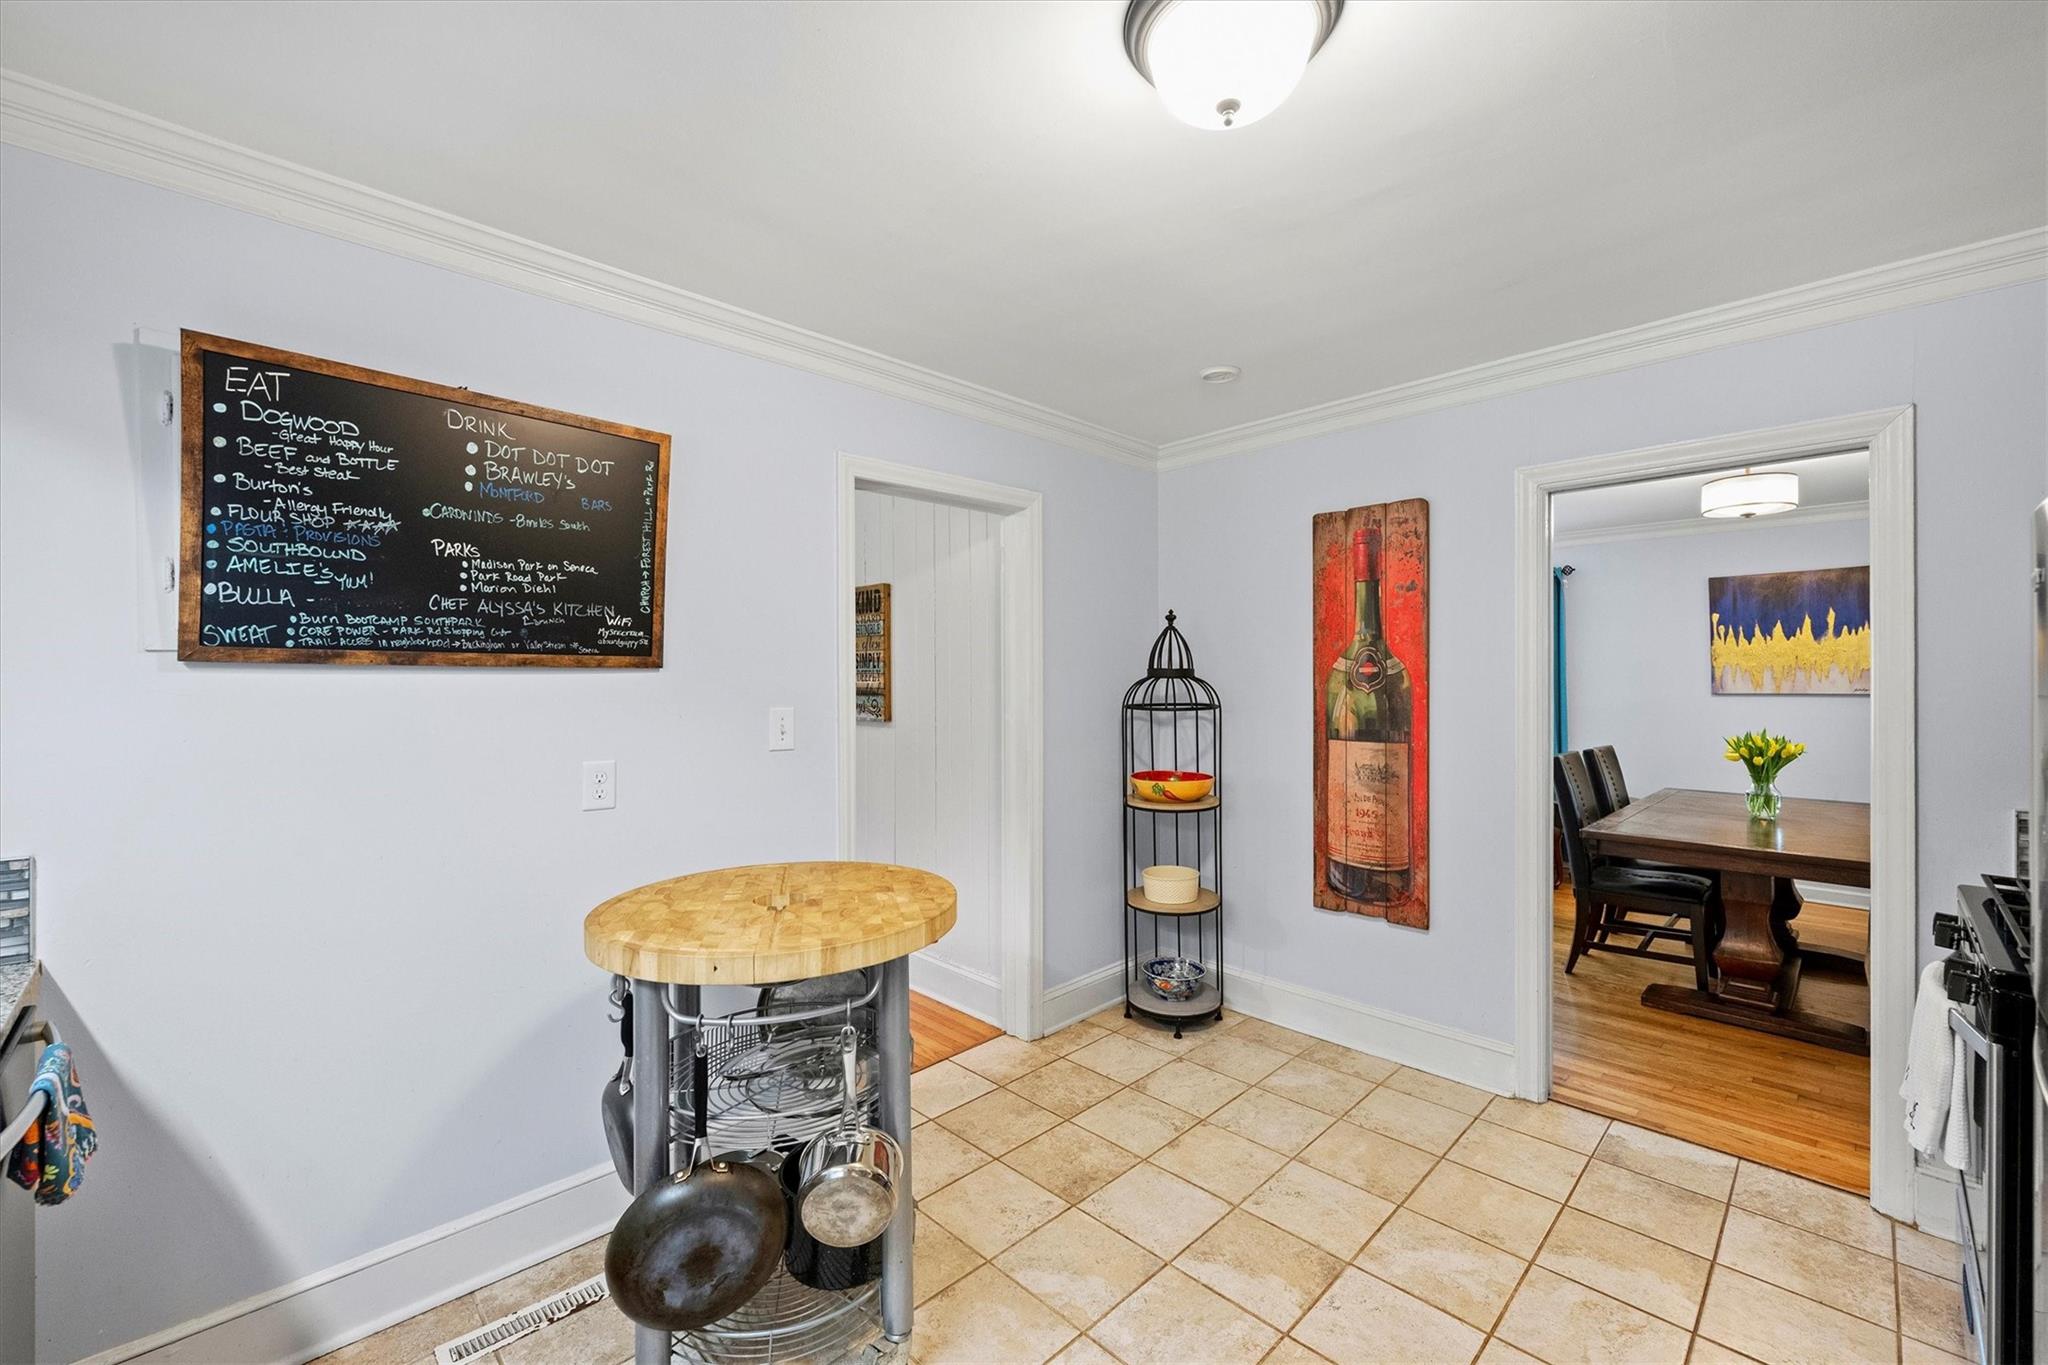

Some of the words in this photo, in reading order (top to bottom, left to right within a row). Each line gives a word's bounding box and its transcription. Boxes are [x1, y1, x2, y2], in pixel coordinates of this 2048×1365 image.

[224, 366, 291, 402] EAT
[239, 399, 360, 437] DOGWOOD
[446, 408, 516, 441] DRINK
[236, 436, 298, 461] BEEF
[305, 454, 331, 465] and
[336, 452, 400, 471] BOTTLE
[329, 435, 366, 454] Happy
[368, 440, 394, 454] Hour
[484, 440, 526, 463] DOT
[532, 448, 571, 468] DOT
[575, 457, 616, 476] DOT
[233, 472, 314, 496] Burton's
[643, 474, 654, 496] Park
[227, 504, 286, 523] FLOUR
[290, 512, 336, 529] SHOP
[332, 503, 393, 521] Friendly
[580, 497, 614, 512] BARS
[559, 519, 591, 532] South
[641, 508, 653, 533] HILL
[221, 520, 277, 537] PASTA
[293, 527, 382, 547] PROVISIONS
[226, 537, 367, 561] SOUTHBOUND
[639, 536, 651, 569] FOREST
[470, 570, 501, 581] Park
[506, 571, 532, 582] Road
[538, 571, 568, 582] Park
[471, 559, 516, 571] Madison
[518, 559, 543, 571] Park
[563, 561, 600, 575] Seneca
[334, 572, 375, 591] YUM!
[471, 582, 517, 593] Marion
[522, 582, 557, 594] Diehl
[218, 581, 296, 607] BULLA
[429, 593, 469, 611] CHEF
[553, 602, 616, 617] KITCHEN
[639, 580, 651, 614] CHURCH
[298, 612, 339, 625] Burn
[344, 613, 409, 627] BOOTCAMP
[413, 615, 486, 628] SOUTHPARK
[298, 626, 333, 637] CORE
[337, 626, 381, 637] POWER
[391, 627, 425, 636] PARK
[427, 627, 443, 635] Rd
[203, 624, 278, 646] SWEAT
[298, 638, 338, 647] TRAIL
[339, 638, 374, 647] ACCESS
